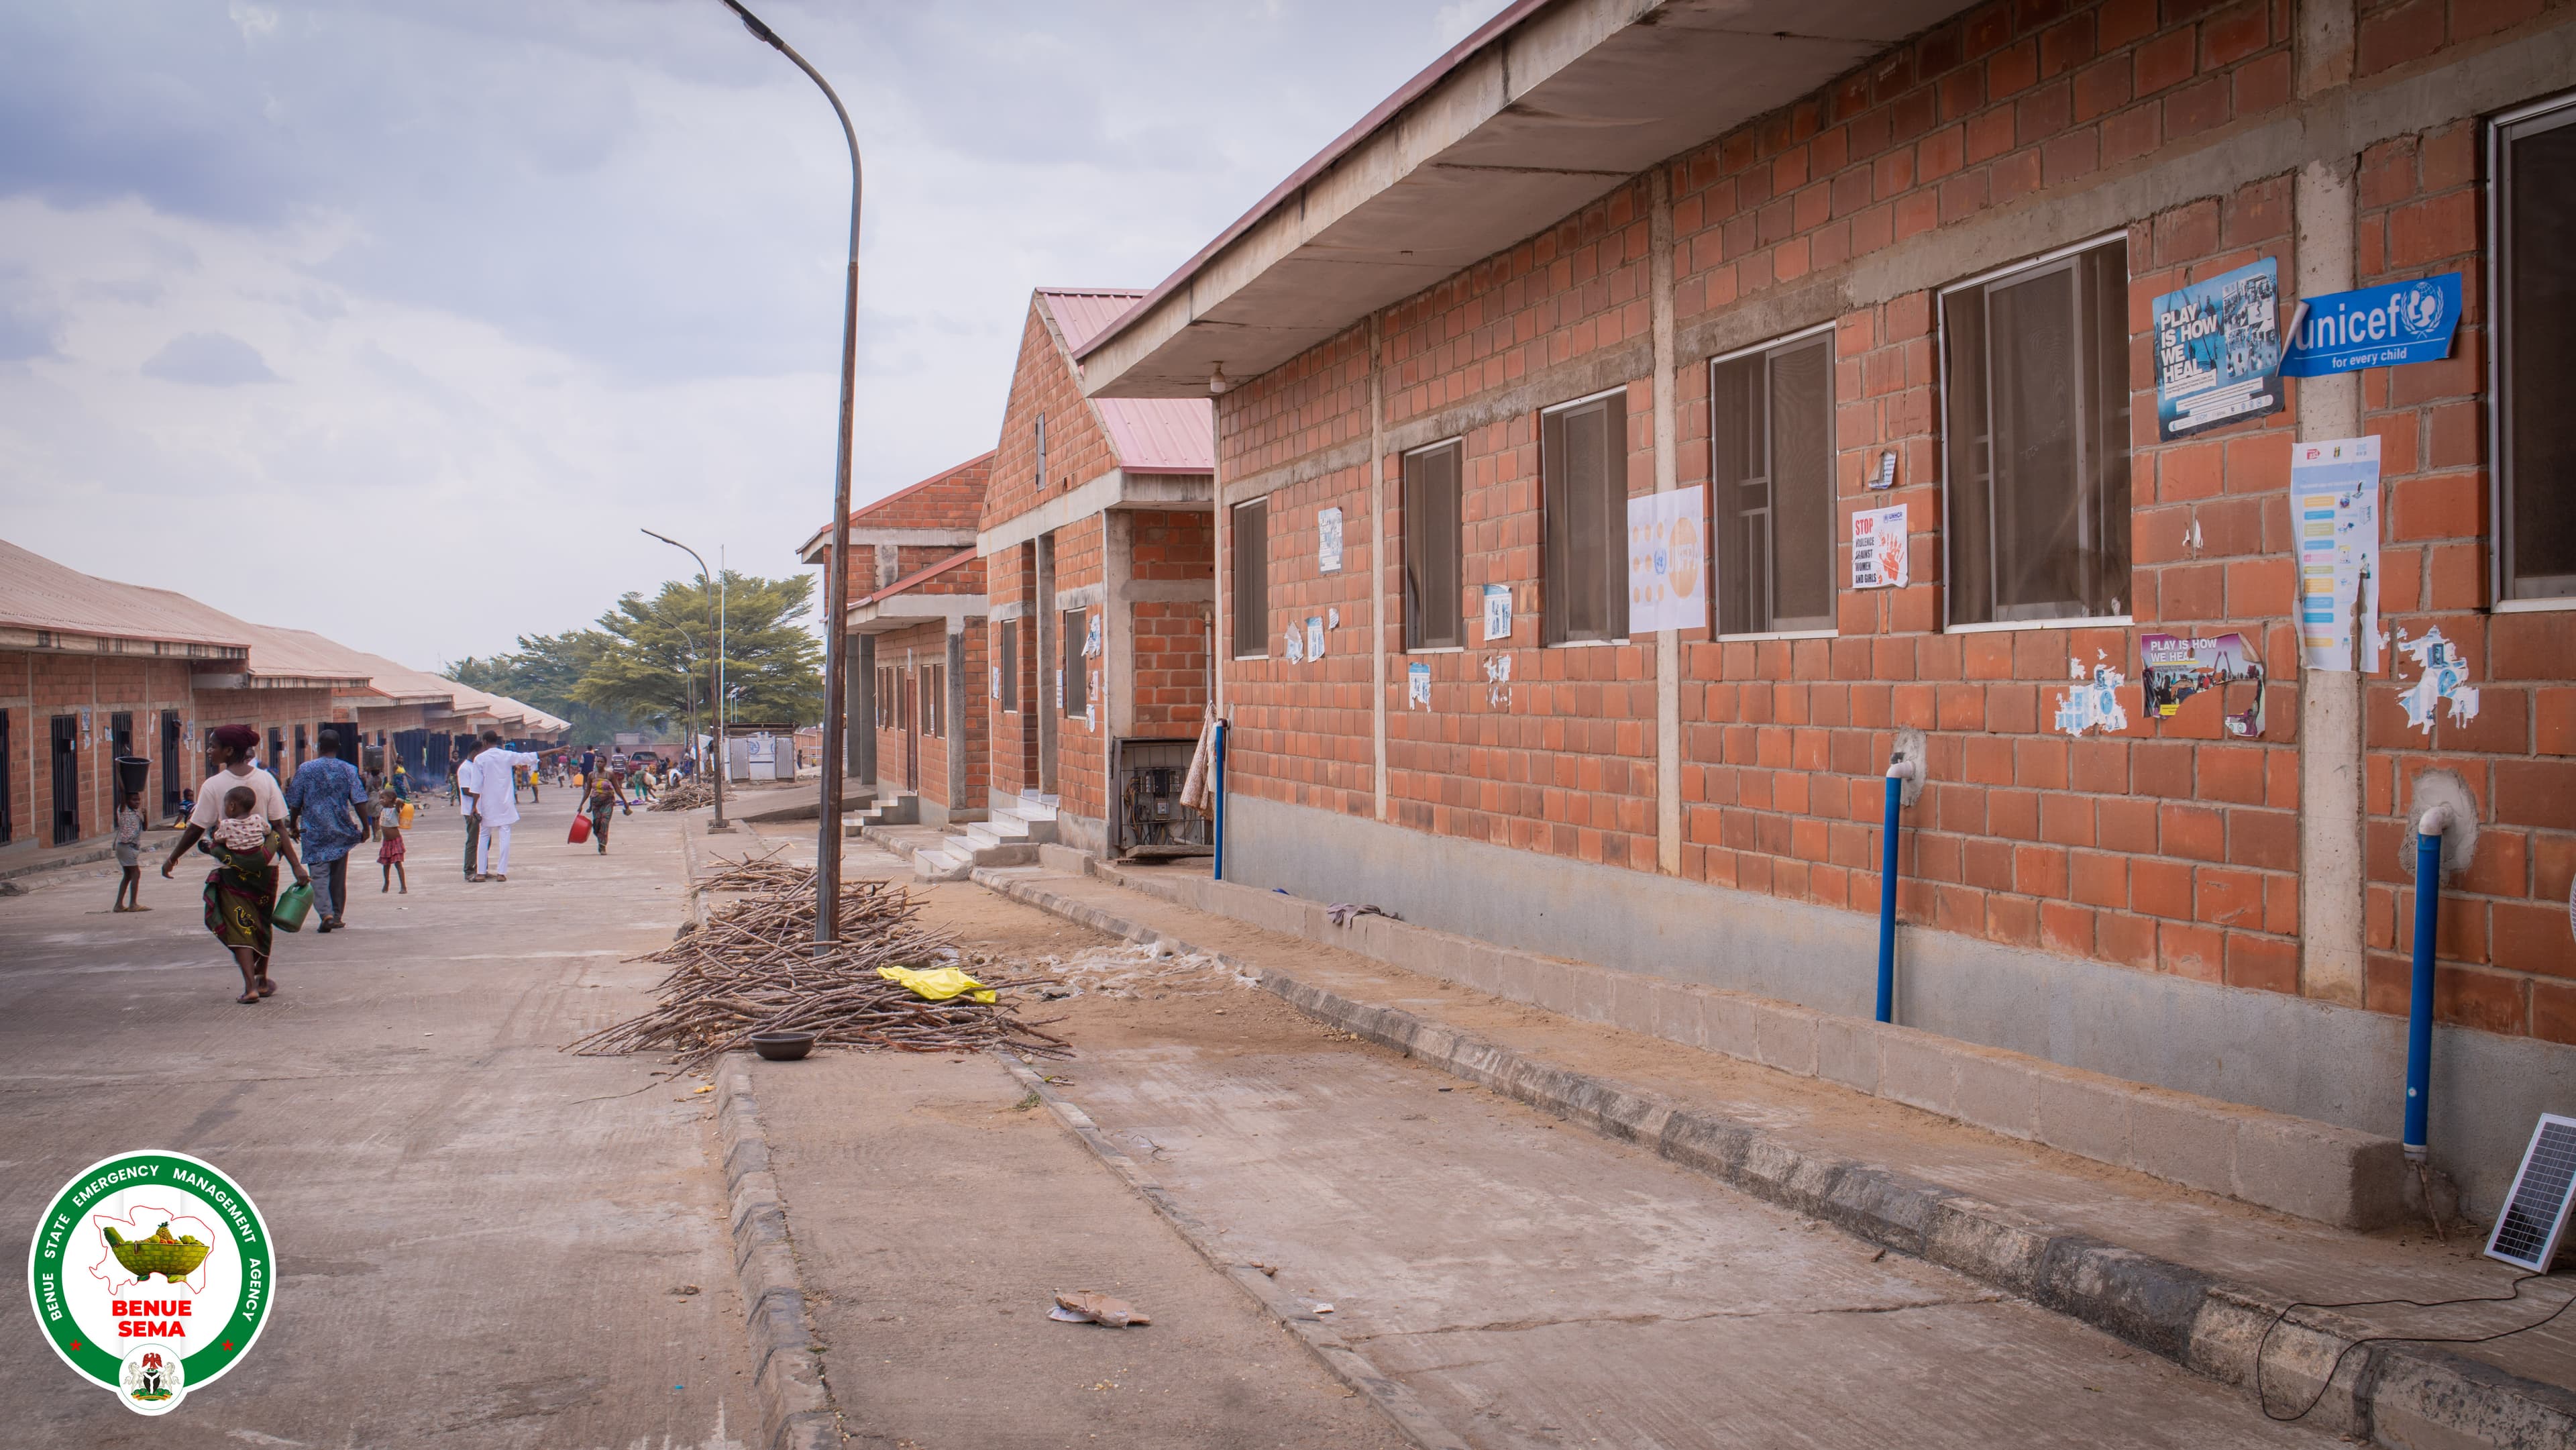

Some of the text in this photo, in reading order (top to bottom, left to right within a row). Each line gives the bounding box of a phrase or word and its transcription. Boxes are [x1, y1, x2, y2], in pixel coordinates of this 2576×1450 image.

[2161, 303, 2198, 331] PLAY
[2296, 293, 2401, 350] unicef
[2161, 314, 2217, 348] IS HOW
[2161, 344, 2185, 366] WE
[2332, 348, 2407, 368] for every child
[2163, 358, 2203, 382] HEAL
[1856, 517, 1873, 535] STOP
[1856, 537, 1874, 548] VIOLENCE
[1855, 549, 1873, 560] AGAINST
[1855, 562, 1871, 572] WOMEN
[1856, 573, 1876, 584] AND GIRLS
[2151, 638, 2217, 651] PLAY IS HOW
[2151, 652, 2166, 662] WE
